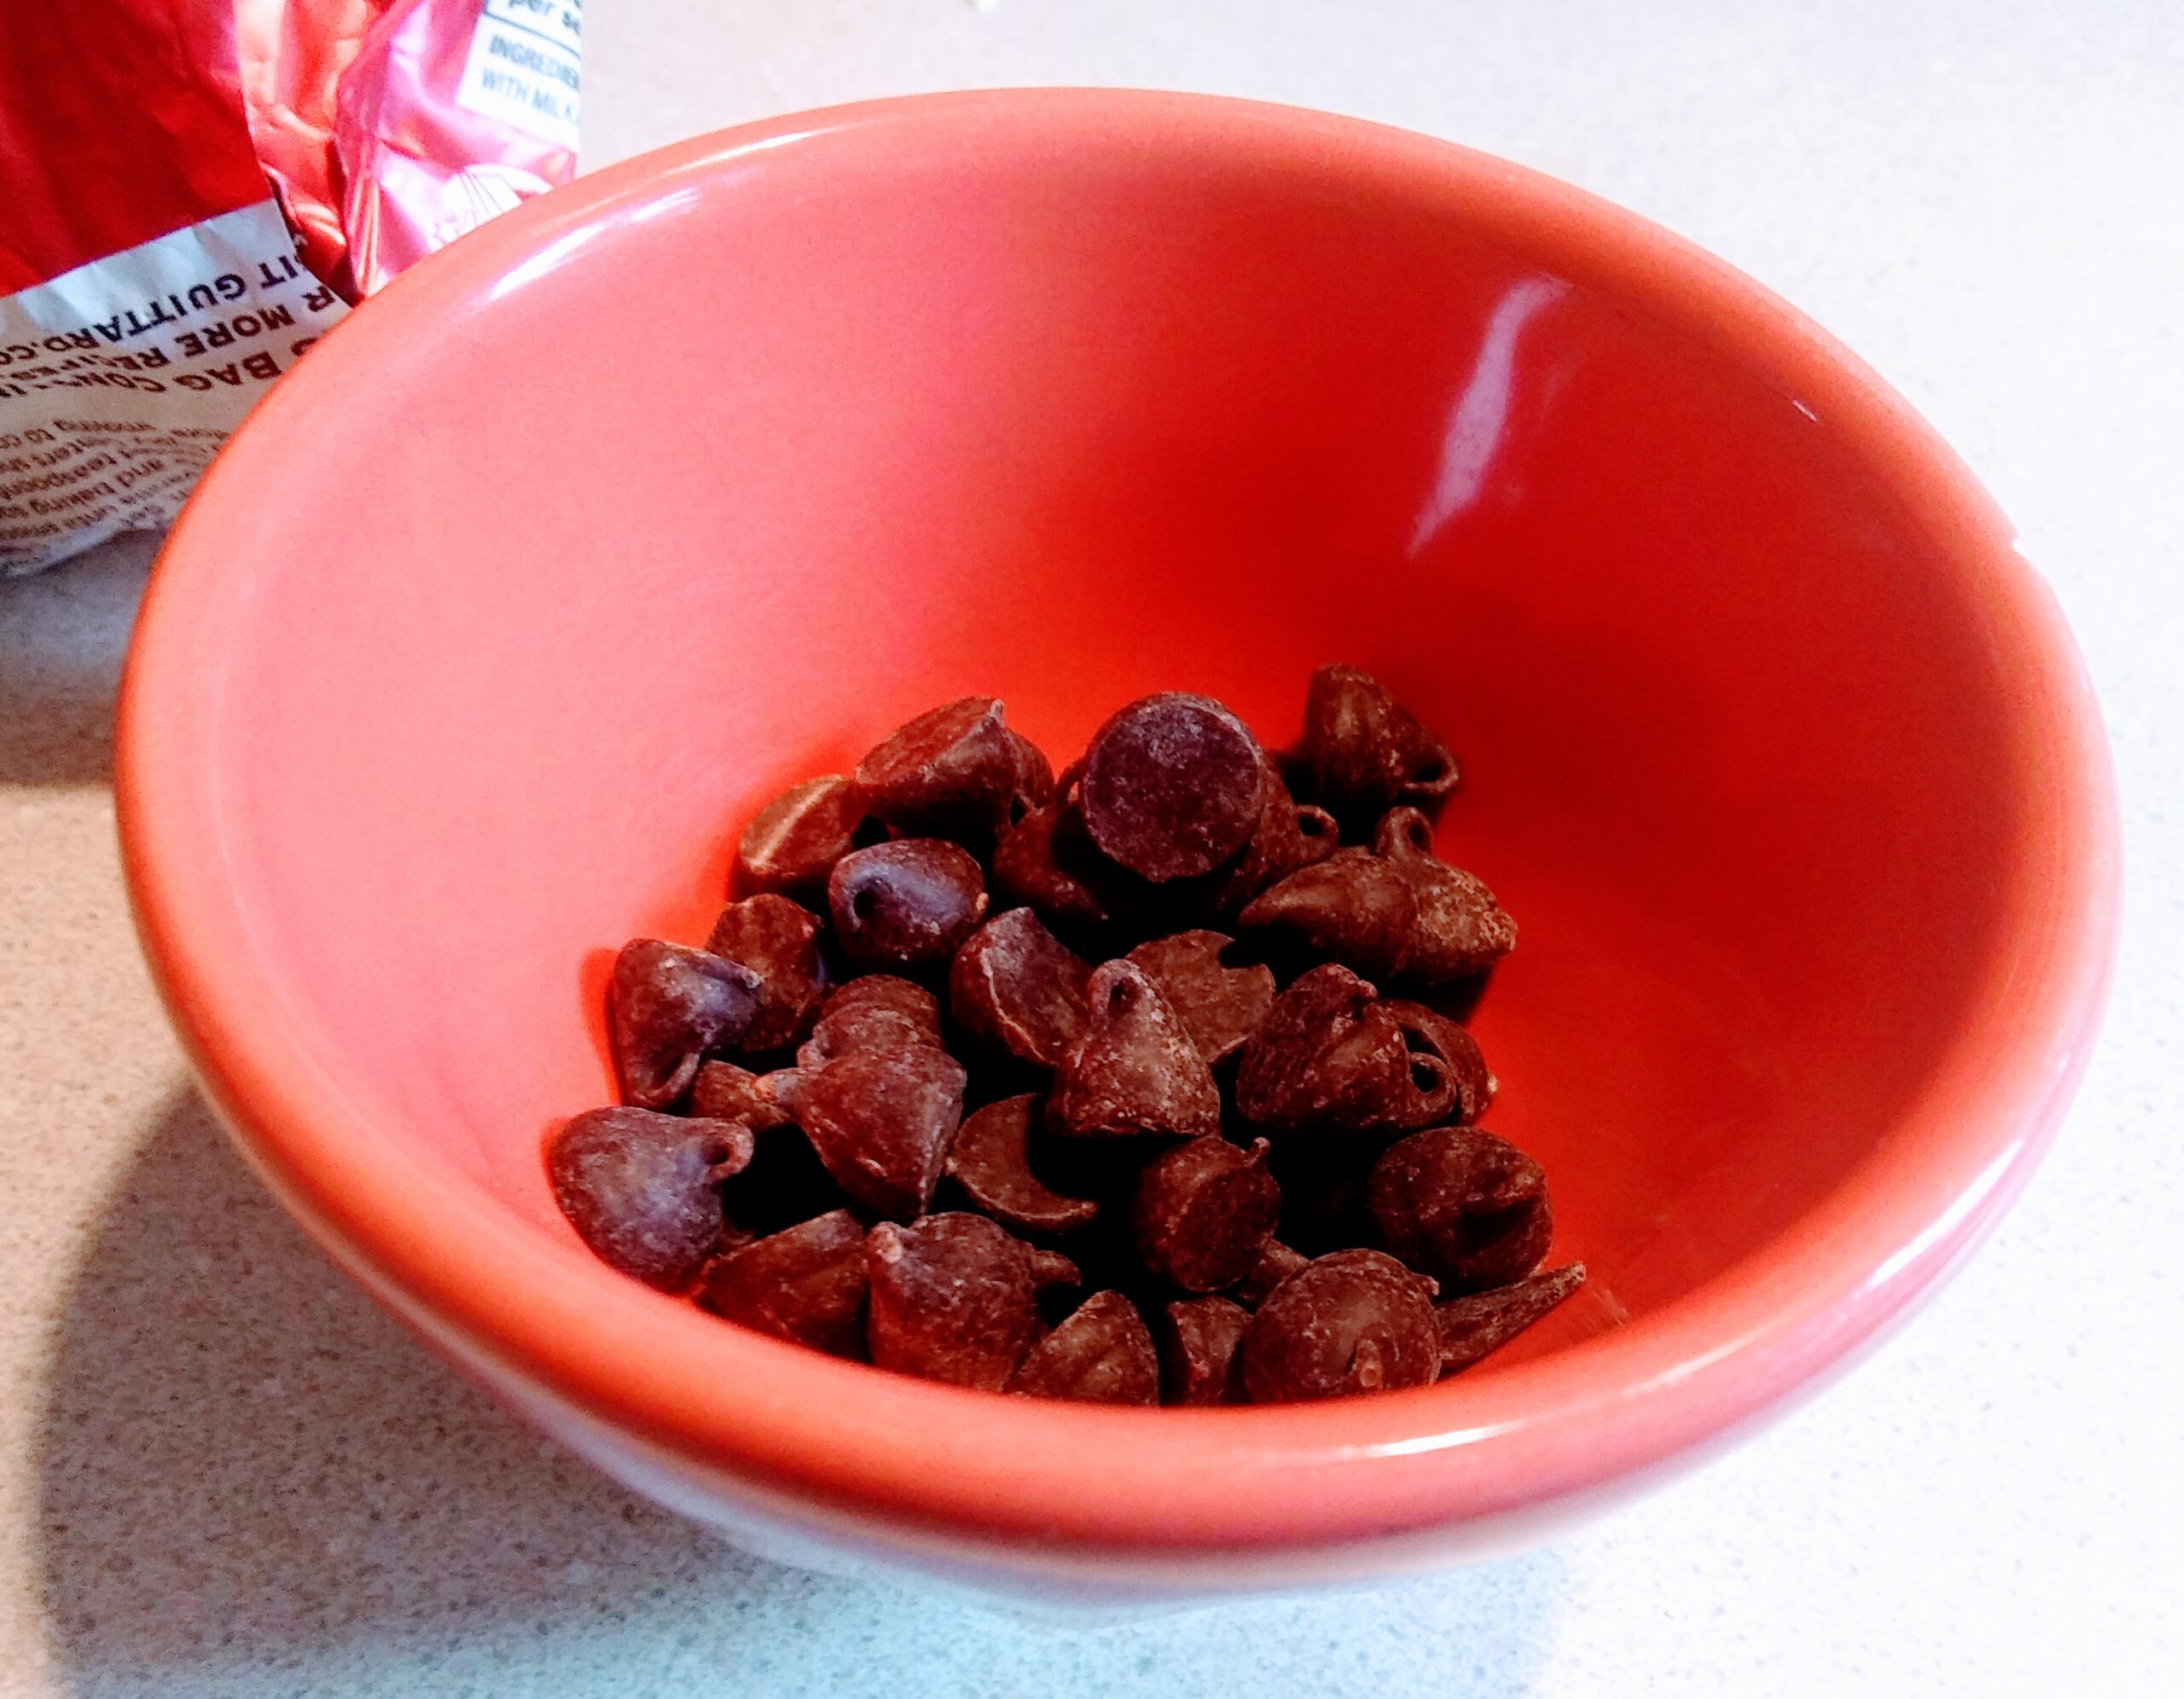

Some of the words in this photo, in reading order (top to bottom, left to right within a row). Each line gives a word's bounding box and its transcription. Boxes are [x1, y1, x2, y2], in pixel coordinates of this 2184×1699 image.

[481, 67, 528, 103] WITH
[258, 255, 301, 289] IT
[175, 304, 296, 358] MORE
[172, 351, 283, 391] BAG
[116, 458, 165, 488] and
